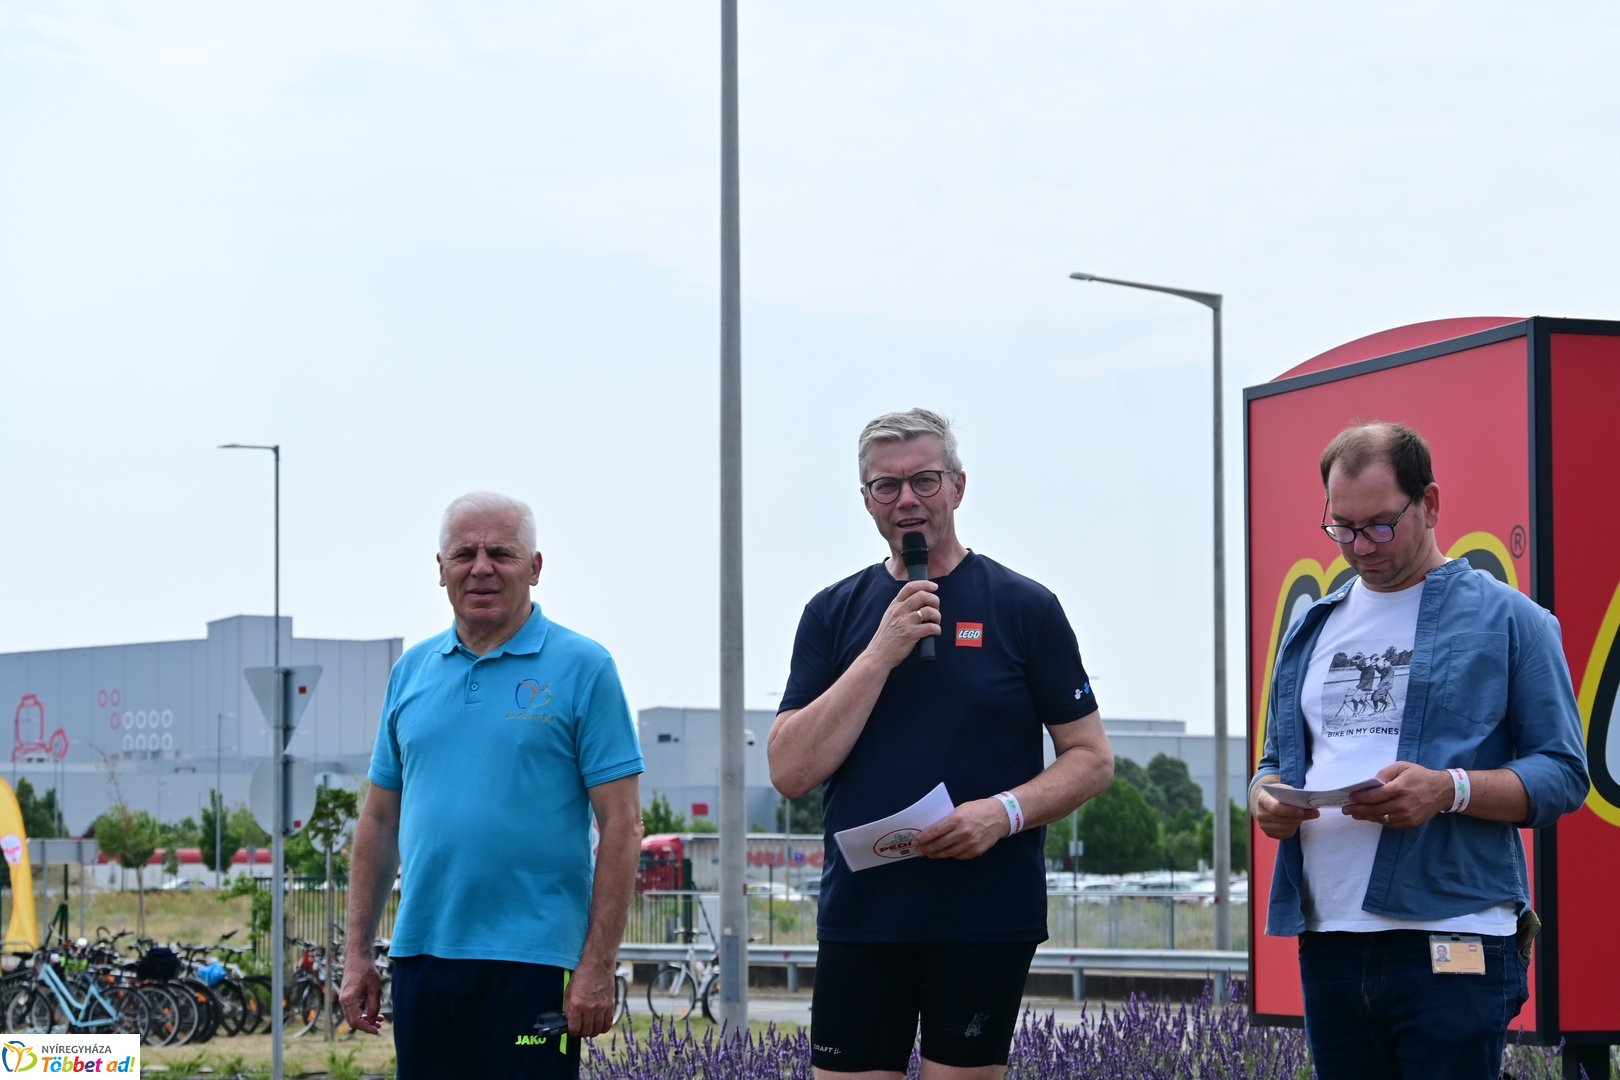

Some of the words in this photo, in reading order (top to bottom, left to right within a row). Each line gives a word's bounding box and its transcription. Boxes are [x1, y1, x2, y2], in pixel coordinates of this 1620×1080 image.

[958, 629, 981, 639] LEGO
[1355, 727, 1368, 735] MY
[1369, 726, 1400, 735] GENES
